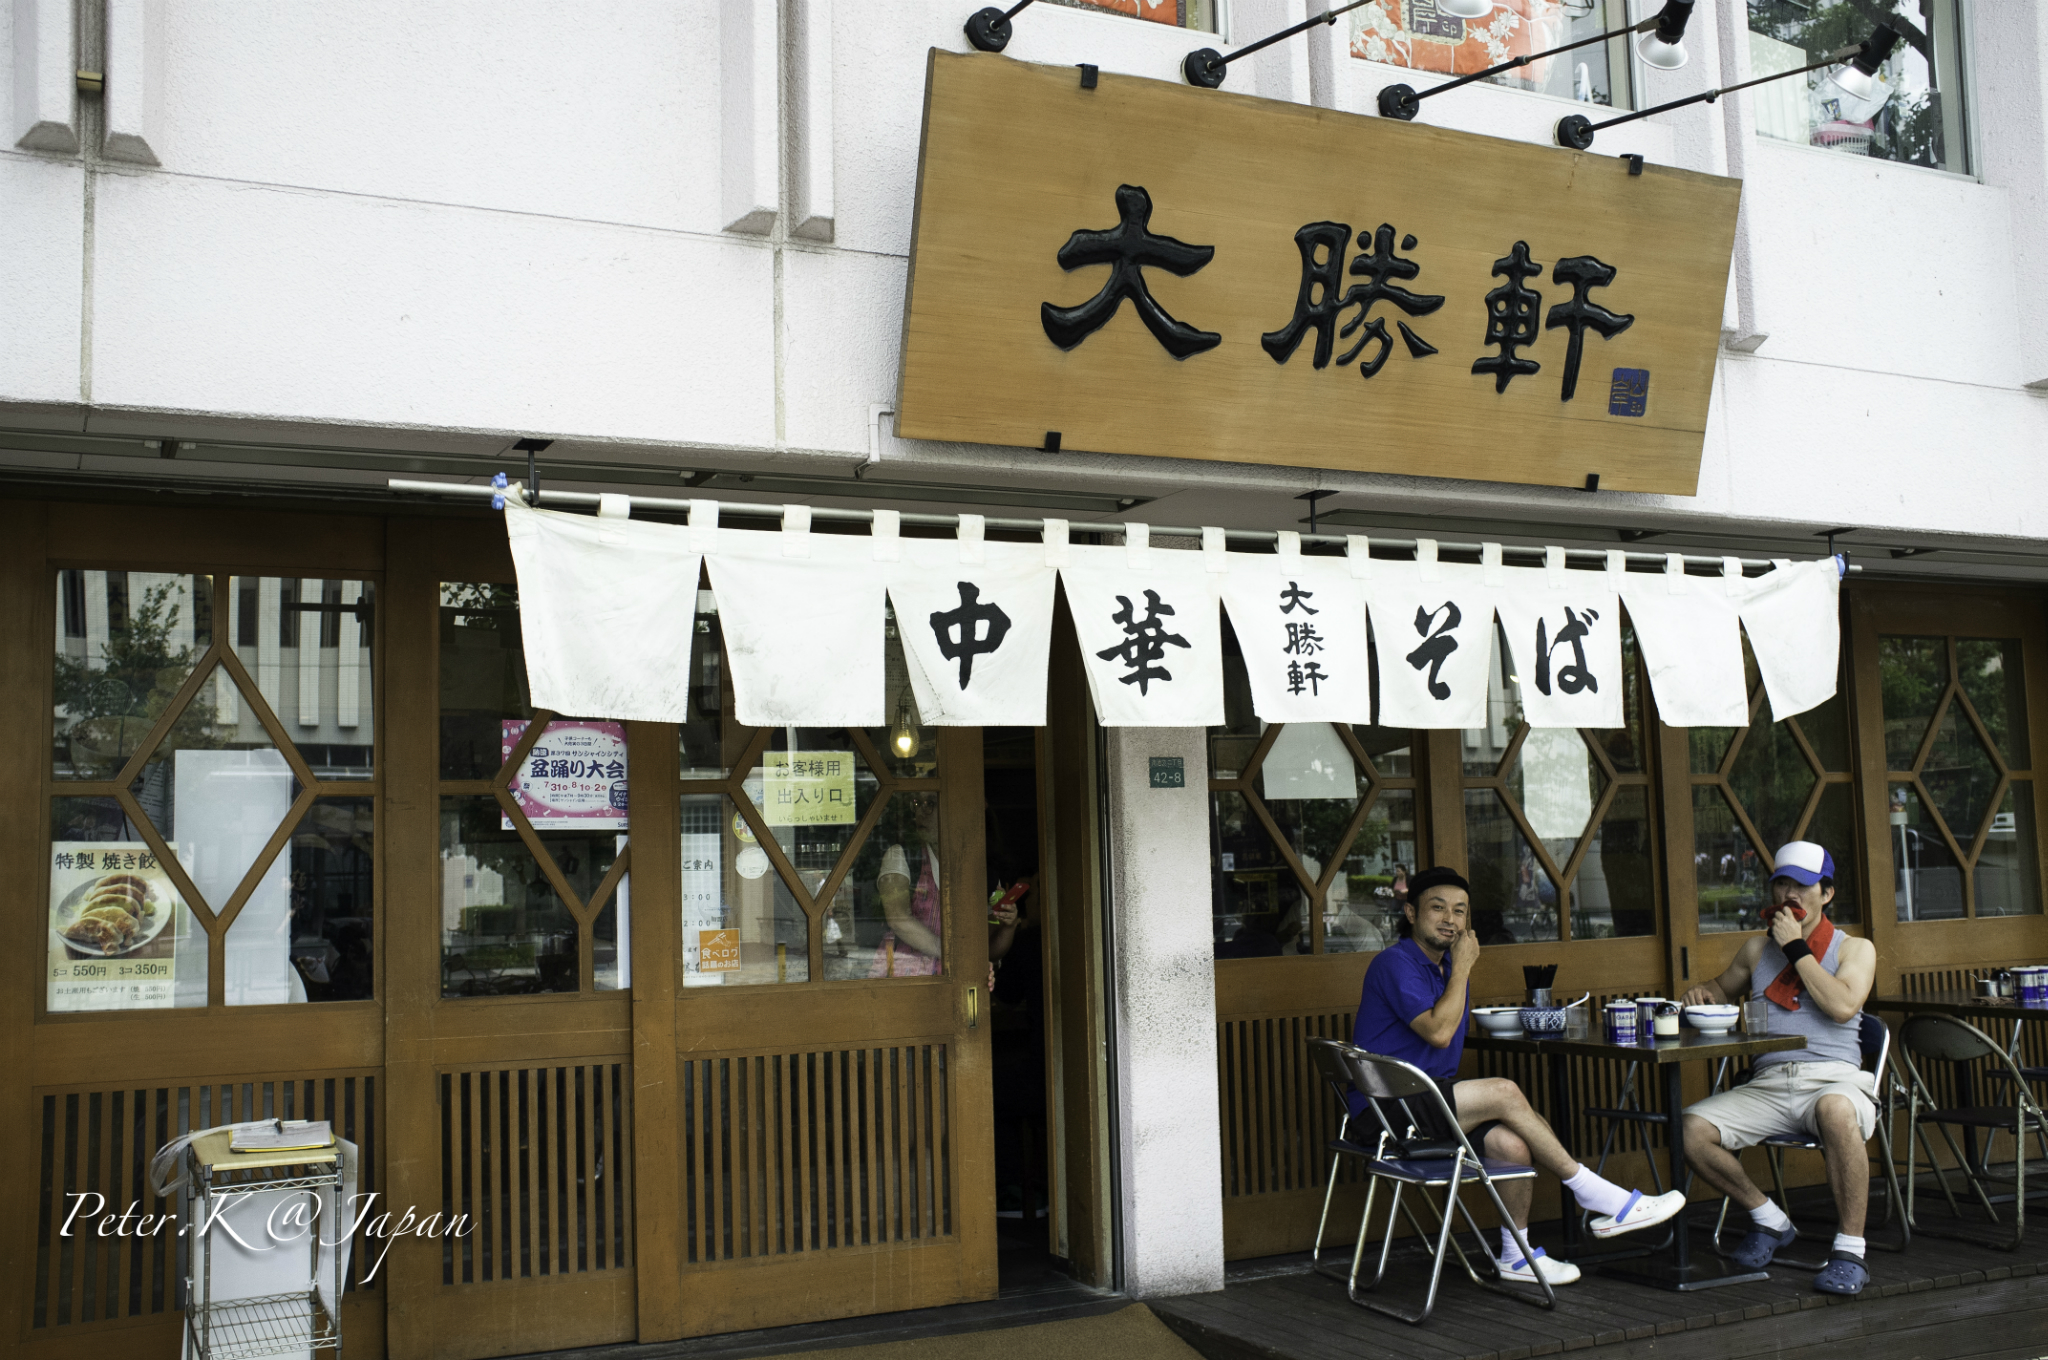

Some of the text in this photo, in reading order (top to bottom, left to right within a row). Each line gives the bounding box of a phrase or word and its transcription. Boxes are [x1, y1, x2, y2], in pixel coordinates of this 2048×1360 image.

[1041, 183, 1635, 402] 大勝軒
[1279, 581, 1329, 697] 大勝軒
[531, 759, 625, 778] 盆踊り大会
[775, 760, 841, 778] お客様用
[1154, 772, 1182, 784] 42-8
[777, 788, 843, 805] 出入り口
[778, 814, 843, 823] いらっしゃいませ！
[55, 852, 95, 870] 特製
[682, 859, 714, 871] ご案内
[701, 946, 739, 959] 食べログ
[53, 964, 168, 977] 5コ 550円 3コ 350円
[701, 959, 739, 969] 話題のお店
